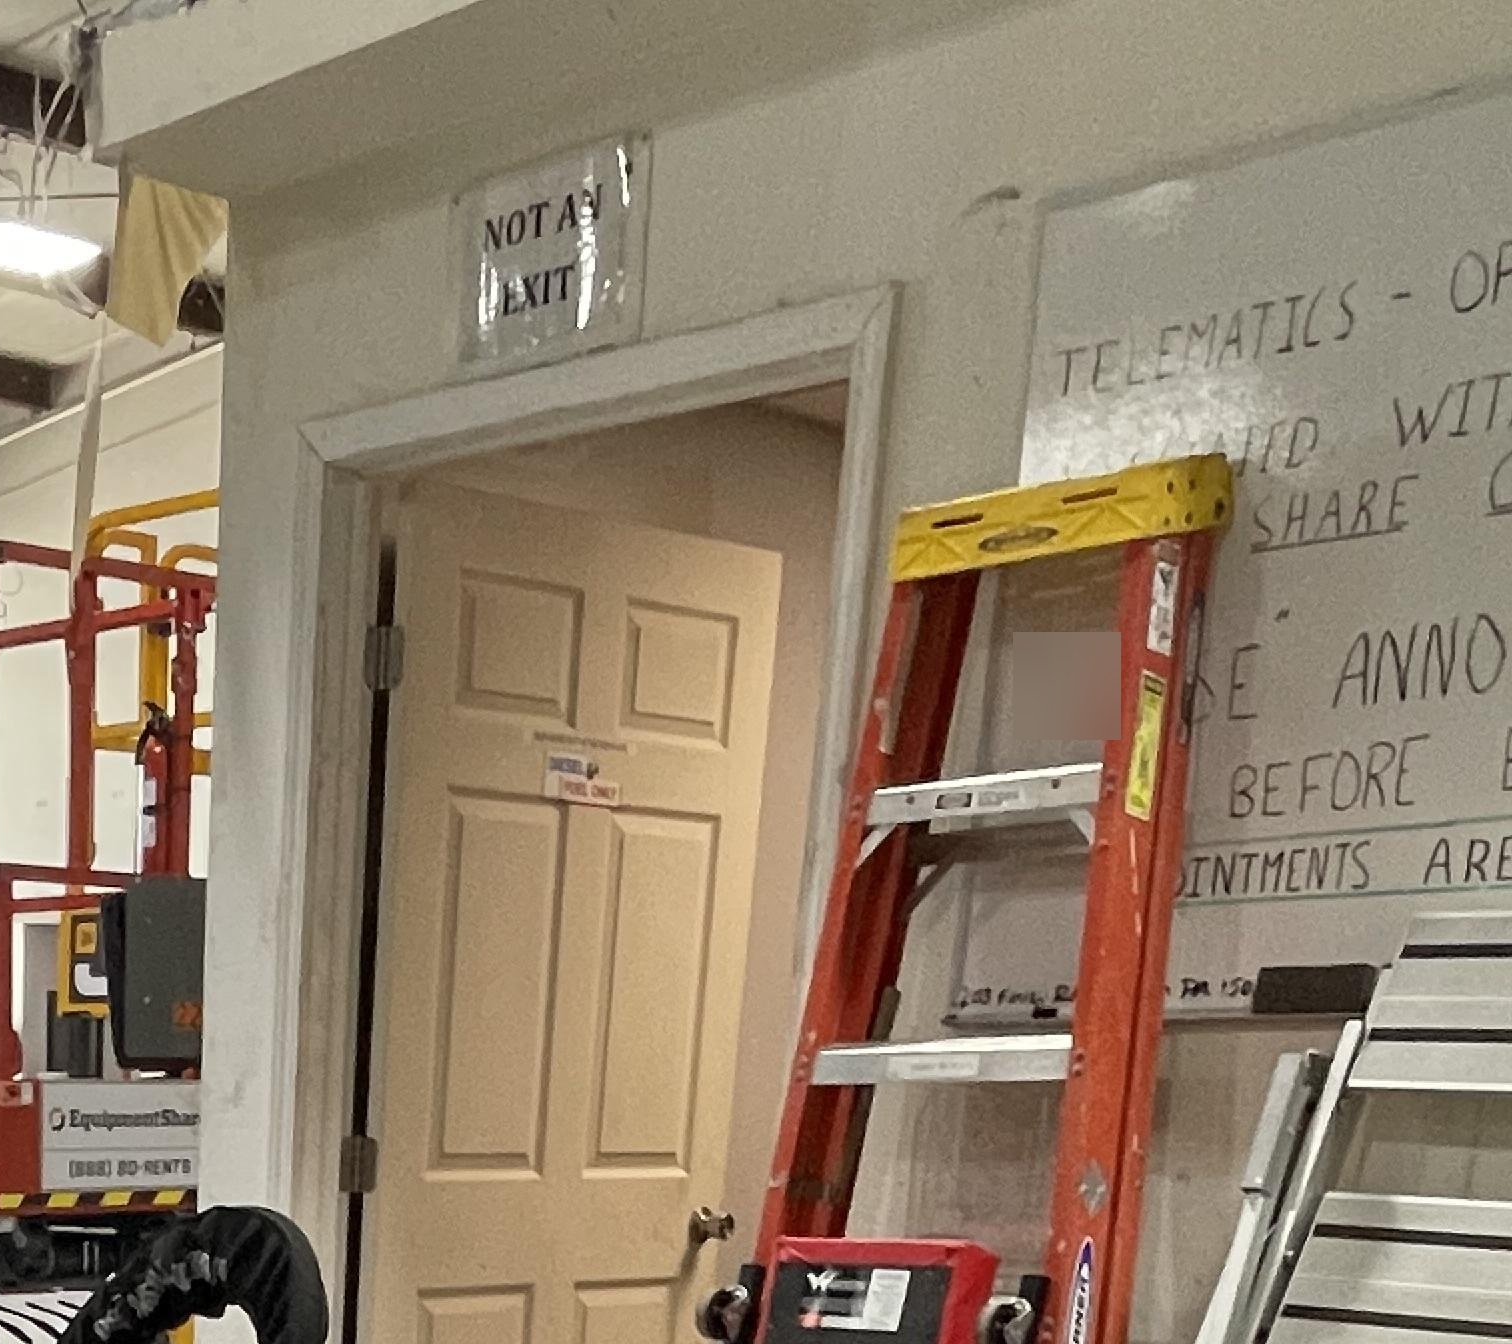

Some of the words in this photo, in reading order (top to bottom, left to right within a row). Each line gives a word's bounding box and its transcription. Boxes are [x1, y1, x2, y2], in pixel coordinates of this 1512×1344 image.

[484, 200, 550, 251] NOT
[556, 183, 603, 233] AN
[502, 264, 575, 316] EXIT
[1057, 281, 1358, 396] TELEMATICS
[1393, 372, 1512, 448] WIT
[1251, 474, 1419, 546] SHARE
[1332, 613, 1507, 709] ANNO
[1229, 734, 1430, 819] BEFORE
[1423, 836, 1512, 885] ARE
[69, 1108, 201, 1132] EquipmentShar
